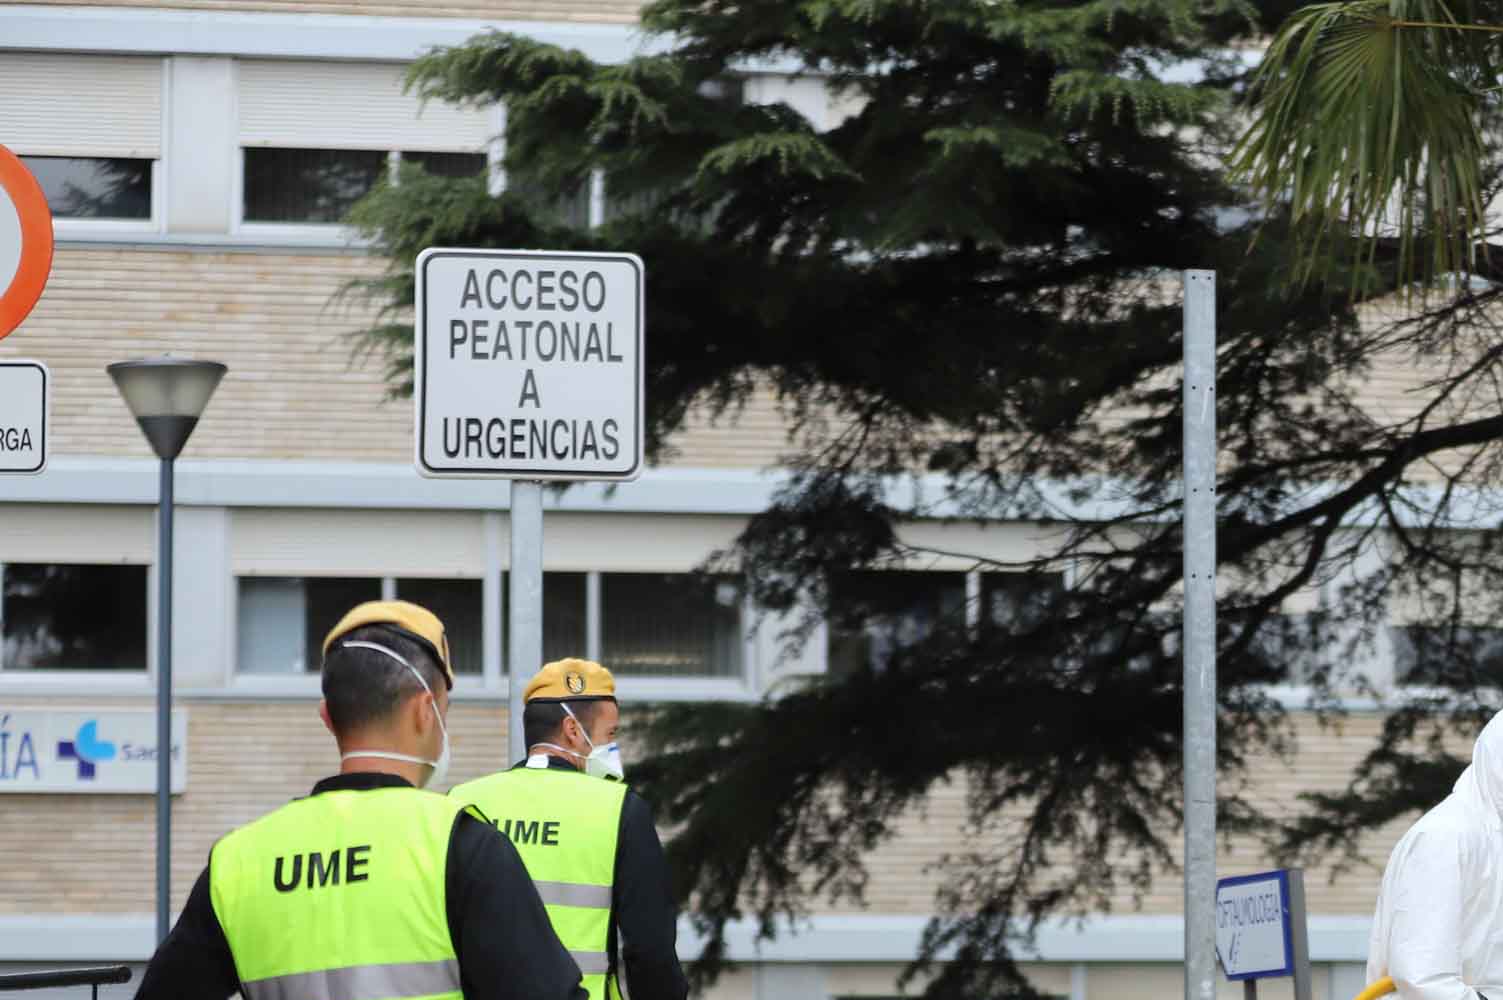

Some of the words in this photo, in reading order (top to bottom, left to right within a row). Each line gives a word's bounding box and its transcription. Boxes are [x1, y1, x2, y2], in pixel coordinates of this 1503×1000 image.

[460, 268, 606, 312] ACCESO
[449, 319, 623, 362] PEATONAL
[518, 368, 541, 408] A
[443, 417, 619, 460] URGENCIAS
[273, 845, 371, 893] UME
